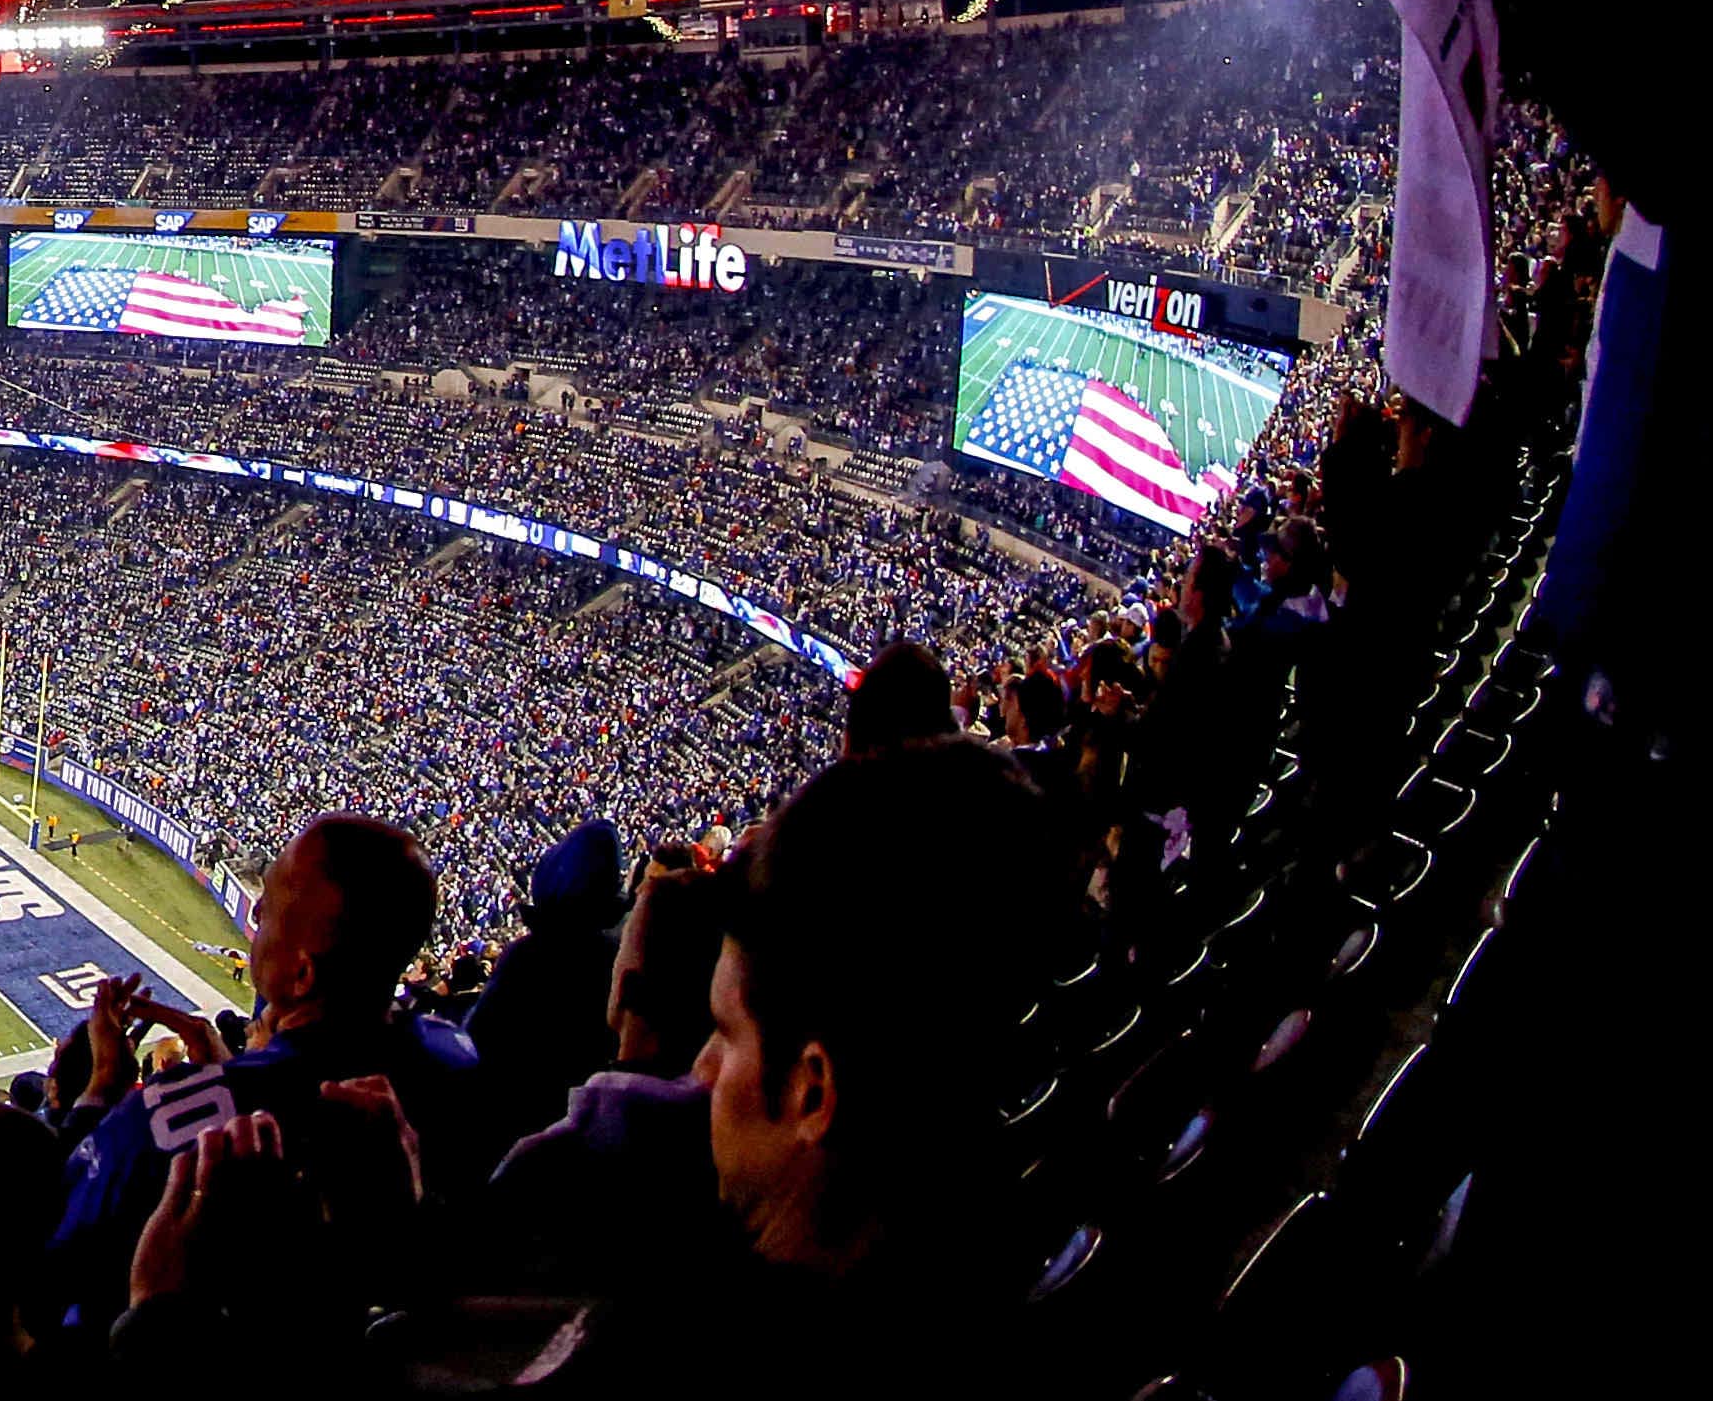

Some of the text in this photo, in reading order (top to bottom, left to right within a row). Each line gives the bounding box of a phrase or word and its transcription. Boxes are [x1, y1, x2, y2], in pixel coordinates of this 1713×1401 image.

[54, 212, 85, 232] SAP
[154, 215, 185, 233] SAP
[248, 215, 279, 234] SAP
[554, 220, 749, 293] MetLife
[1107, 275, 1203, 339] verizon
[62, 762, 190, 860] NEW YORK FOOTBALL GIANTS
[142, 1063, 237, 1152] 10
